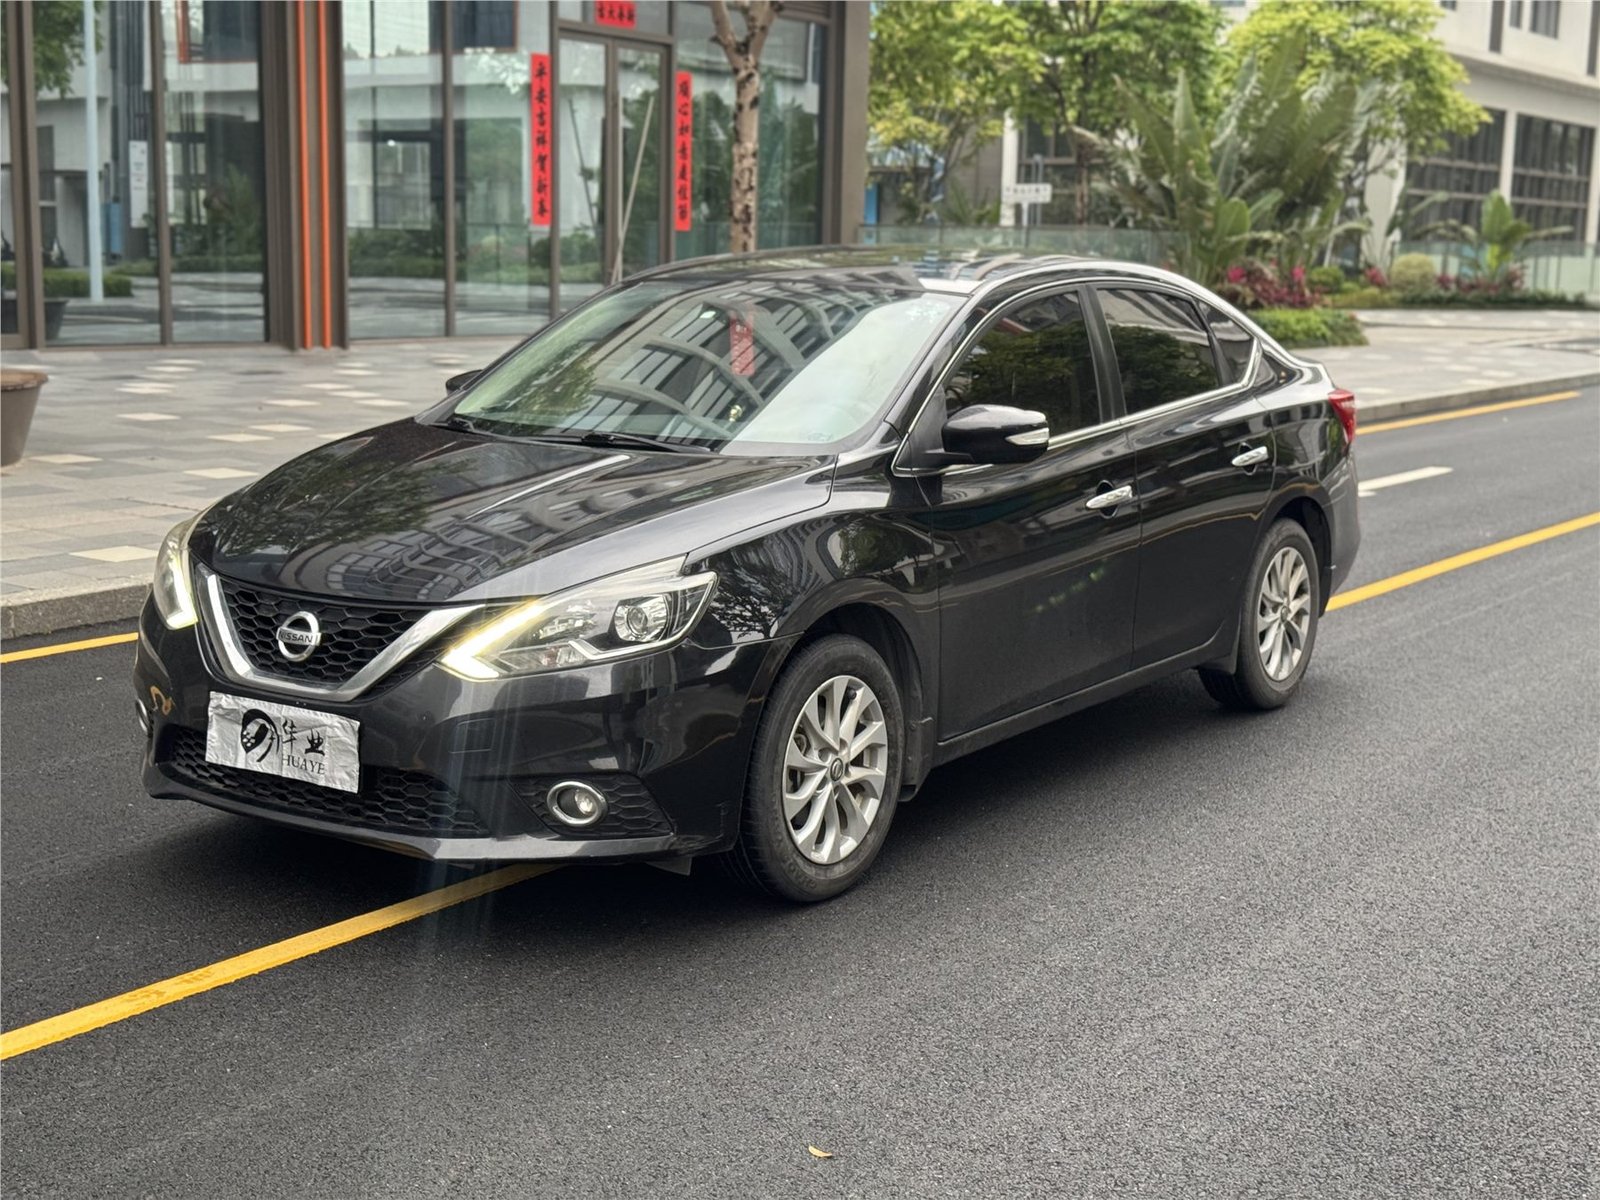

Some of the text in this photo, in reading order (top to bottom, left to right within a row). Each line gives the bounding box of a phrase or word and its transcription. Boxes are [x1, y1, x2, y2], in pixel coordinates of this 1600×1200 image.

[279, 629, 313, 643] NISSAN
[282, 719, 325, 757] 华业
[282, 754, 325, 776] HUAYE
